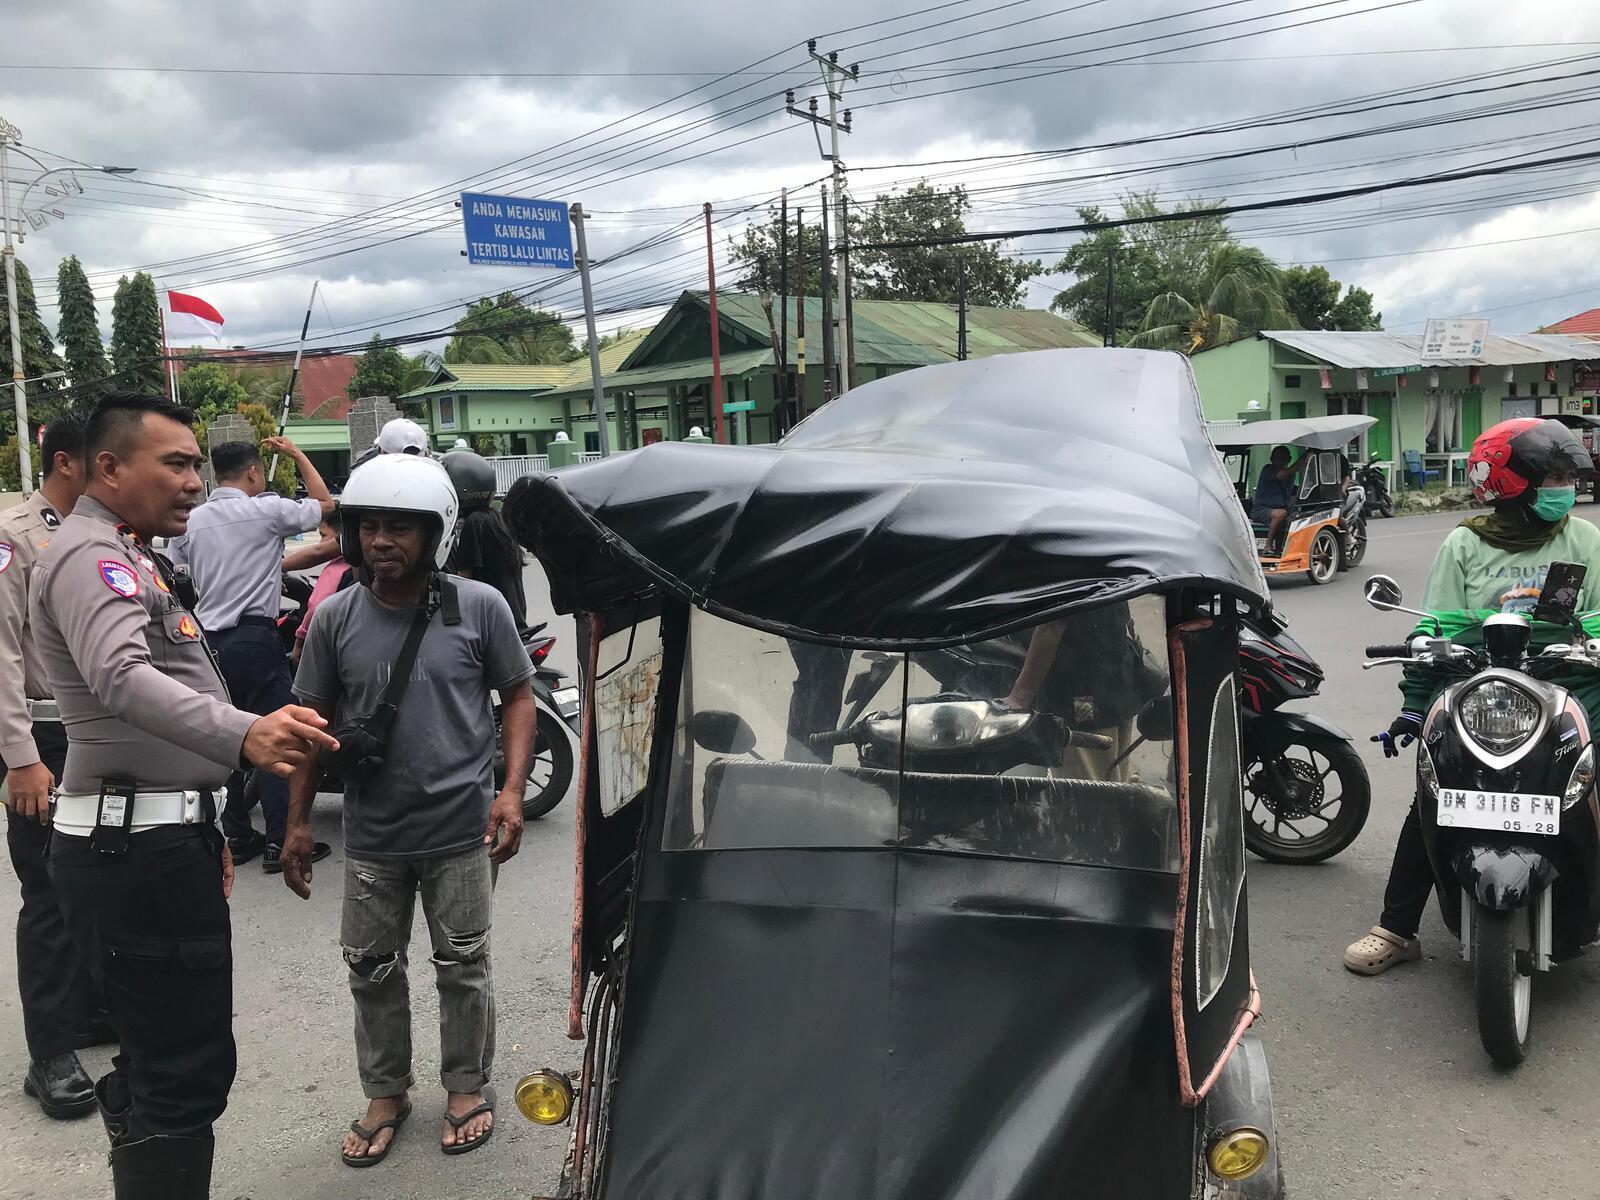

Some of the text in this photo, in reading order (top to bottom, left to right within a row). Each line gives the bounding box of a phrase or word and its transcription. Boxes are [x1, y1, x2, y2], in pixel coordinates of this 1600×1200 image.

[473, 202, 561, 222] ANDA MEMASUKI
[494, 224, 545, 240] KAWASAN
[472, 243, 569, 261] TERTIB LALU LINTAS
[1444, 791, 1554, 815] DM 3116 FN
